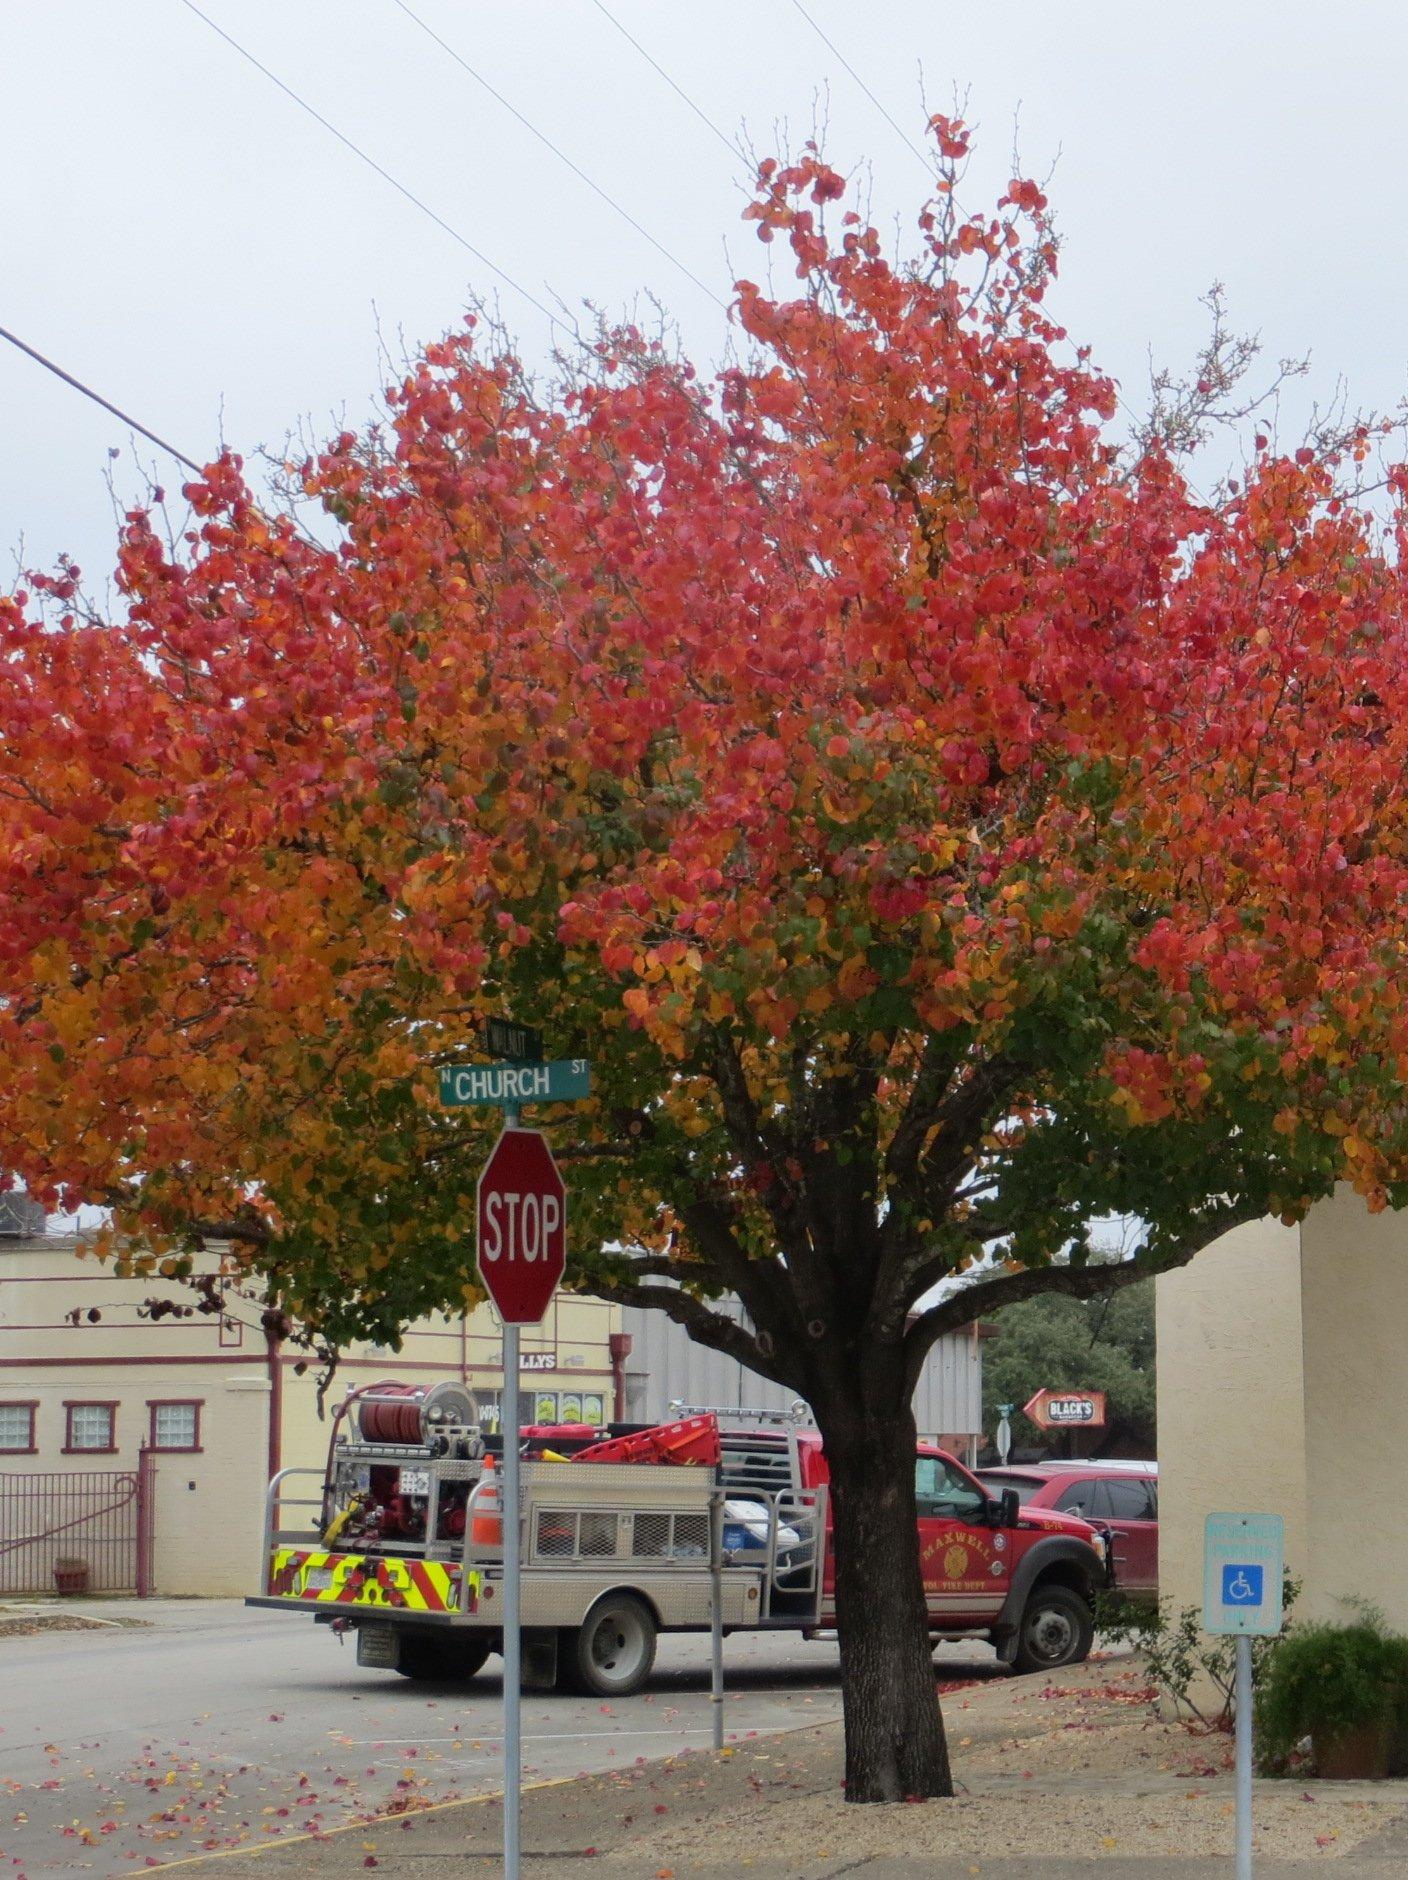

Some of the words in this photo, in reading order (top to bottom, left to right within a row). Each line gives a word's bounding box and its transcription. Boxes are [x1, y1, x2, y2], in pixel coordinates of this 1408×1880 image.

[441, 1069, 451, 1083] N
[455, 1067, 550, 1101] CHURCH
[572, 1059, 586, 1074] ST
[484, 1191, 560, 1263] STOP
[1050, 1402, 1092, 1415] BLACK'S
[923, 1531, 991, 1561] MAXWELL
[942, 1581, 962, 1591] FIRE
